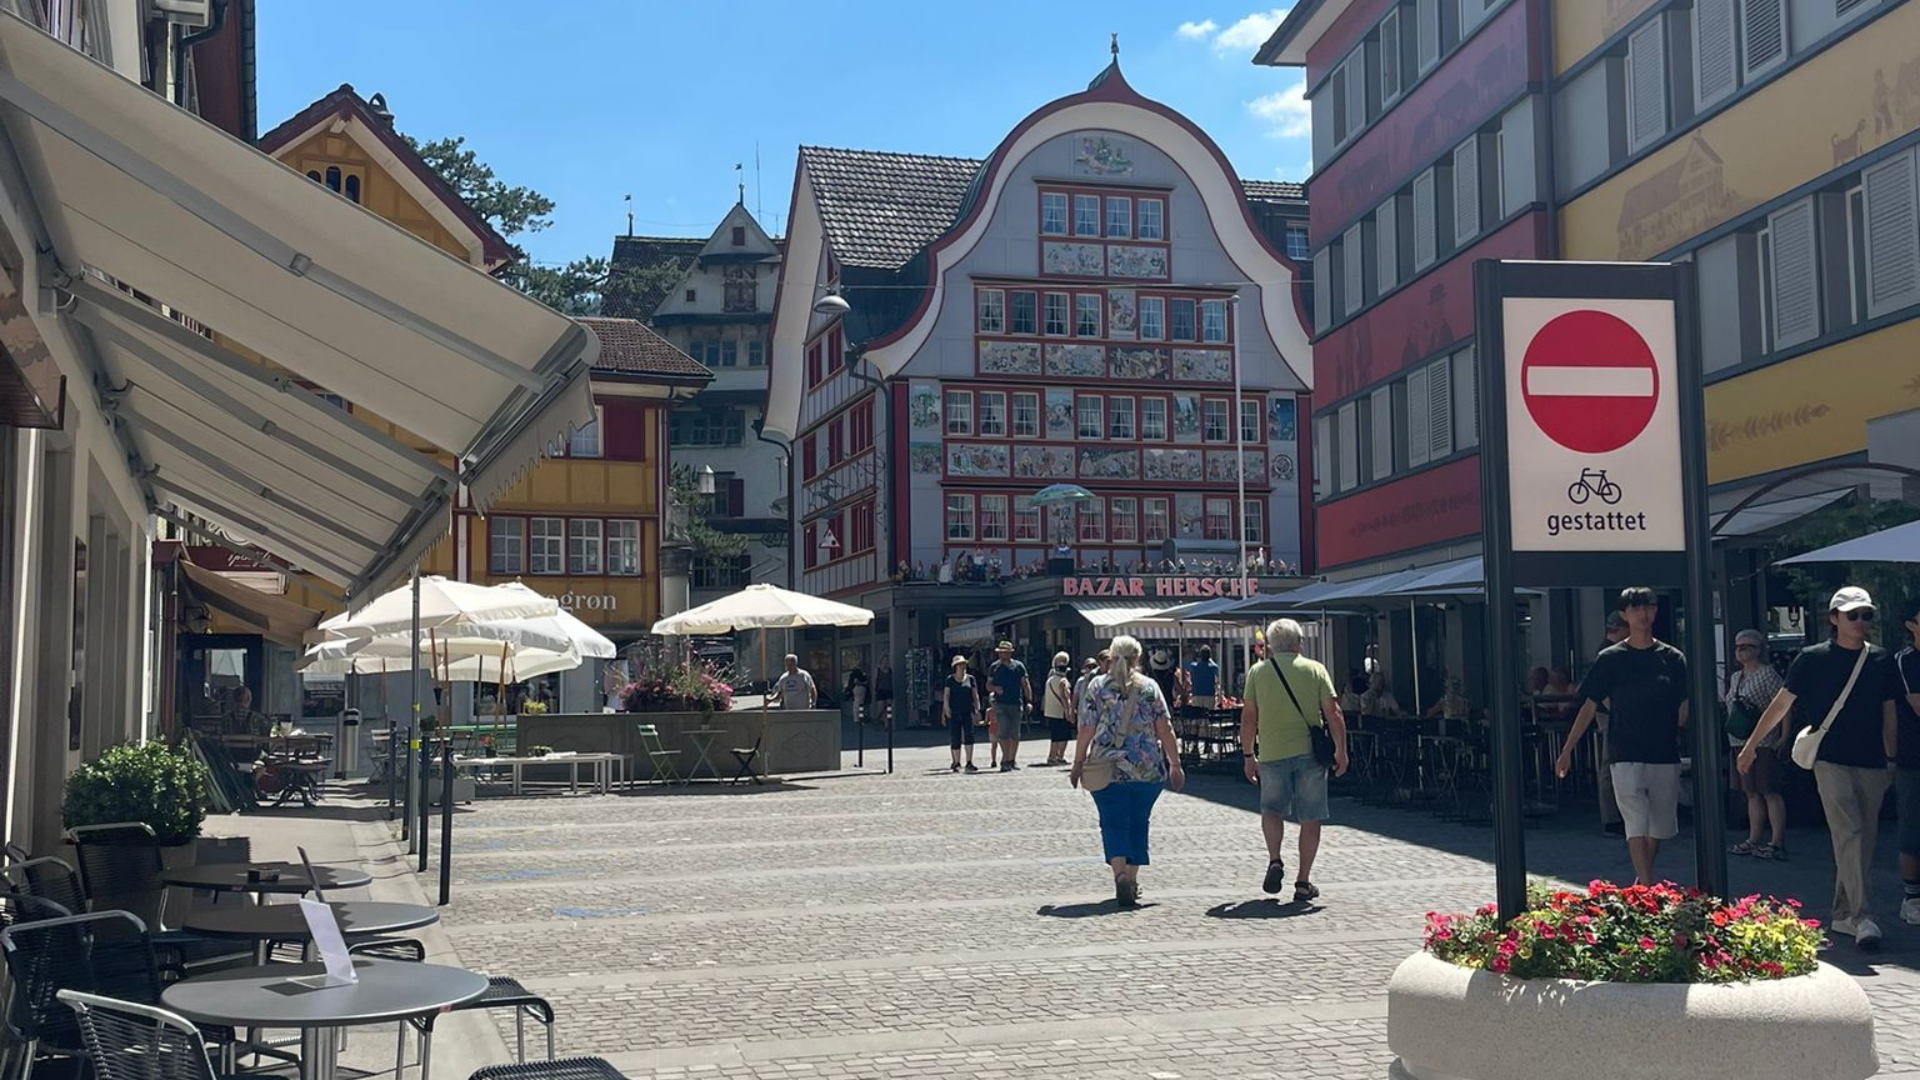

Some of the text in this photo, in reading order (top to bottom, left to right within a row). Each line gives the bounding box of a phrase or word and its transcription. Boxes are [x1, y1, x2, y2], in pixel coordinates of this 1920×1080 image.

[1547, 511, 1646, 536] gestattet
[1063, 577, 1260, 597] BAZAR HERSCHE
